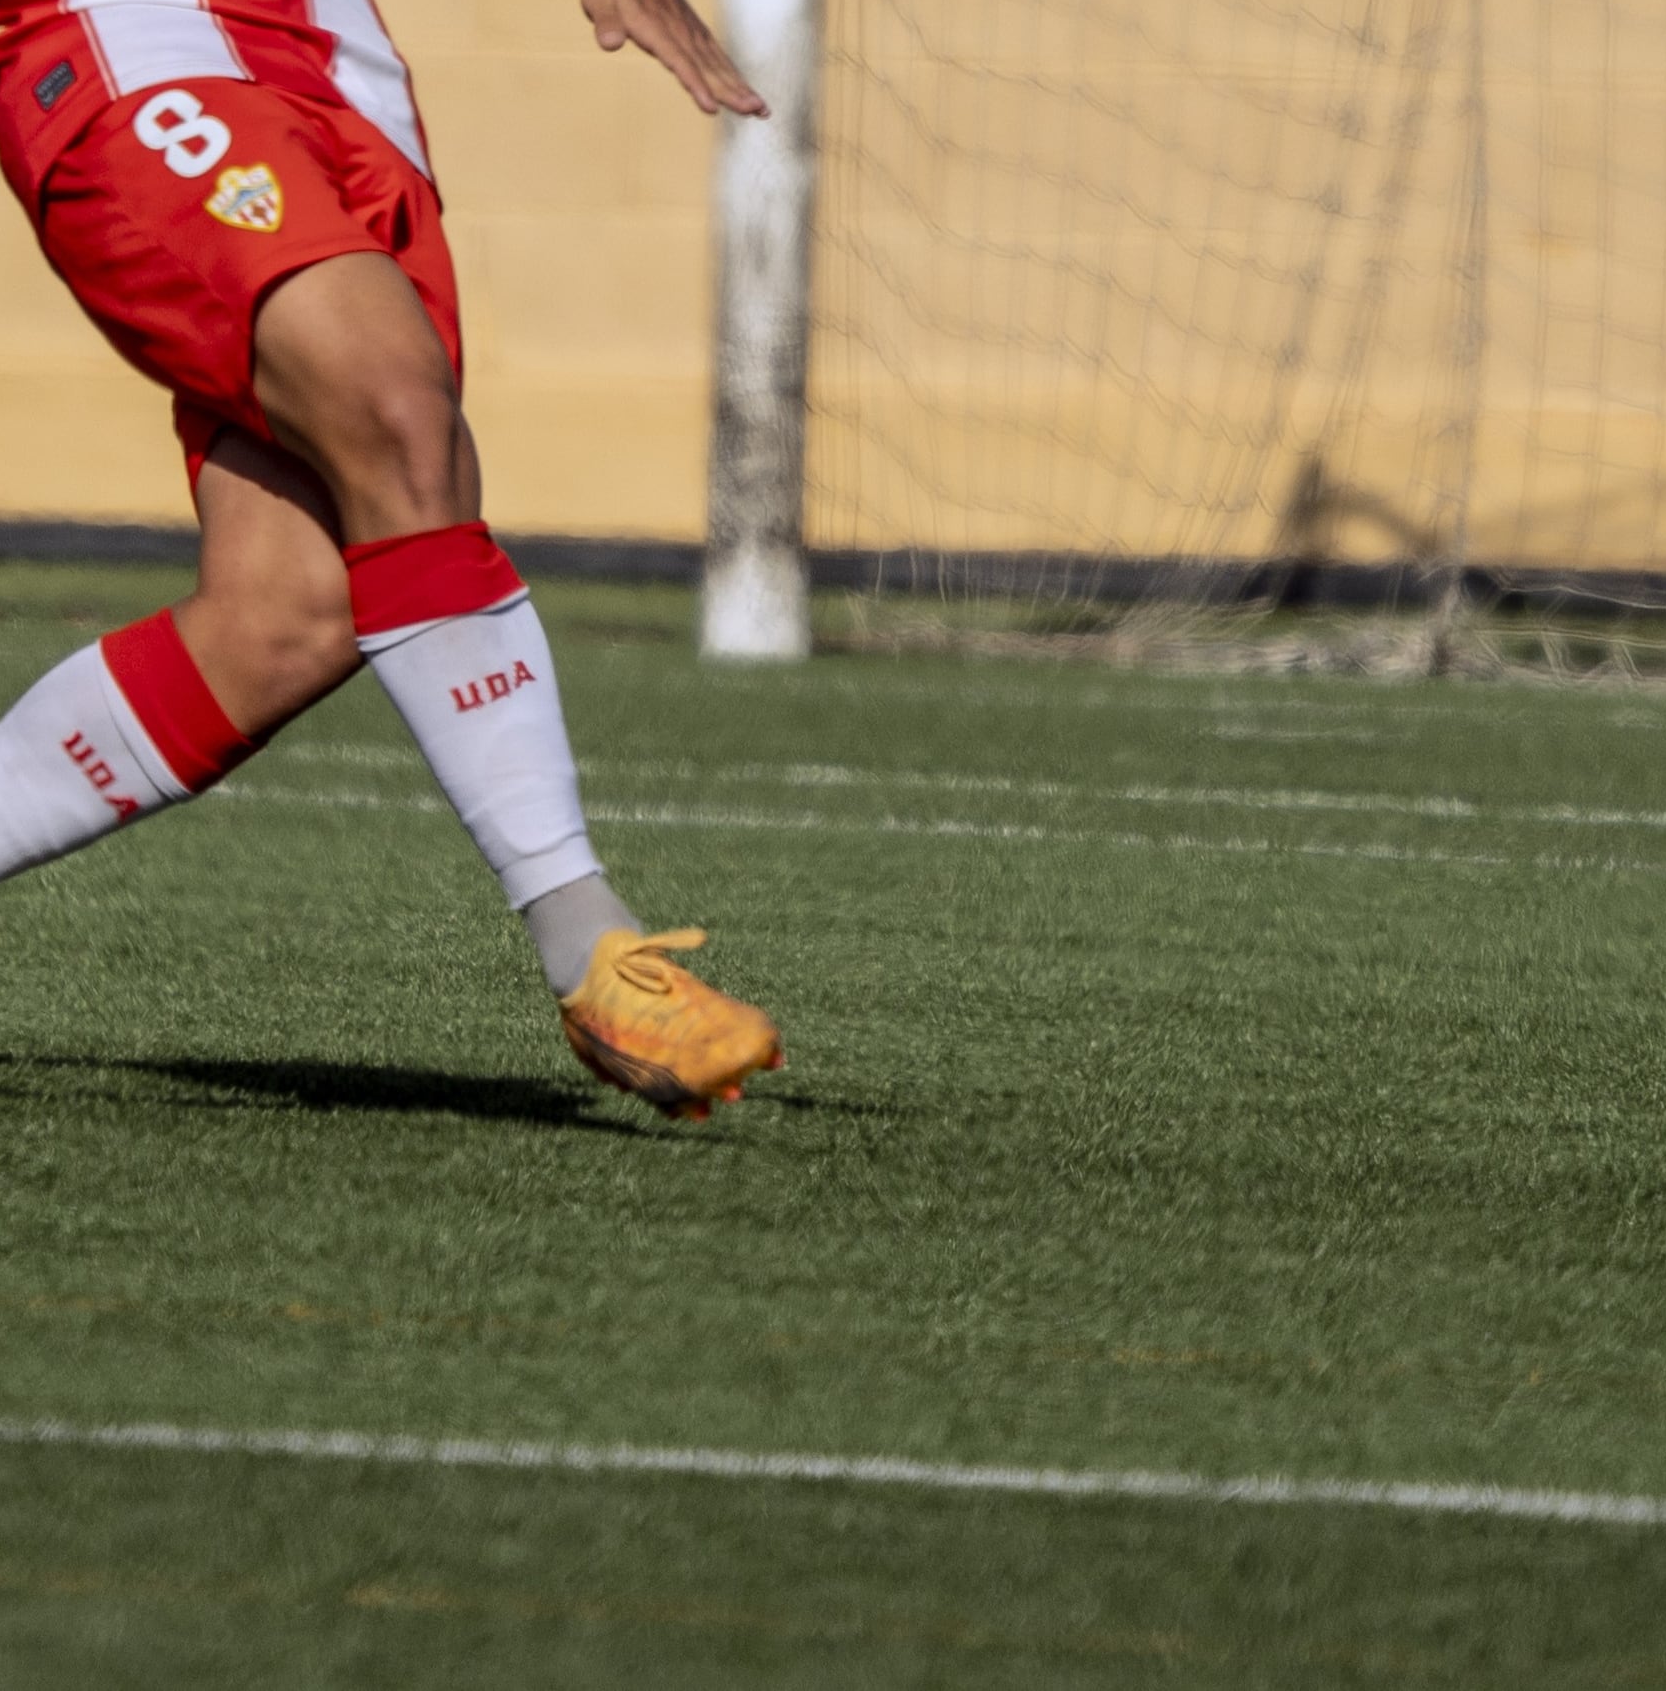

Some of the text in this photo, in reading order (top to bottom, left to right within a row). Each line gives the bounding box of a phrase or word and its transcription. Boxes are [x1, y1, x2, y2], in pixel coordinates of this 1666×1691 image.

[133, 89, 232, 177] 8
[449, 660, 537, 714] UDA
[62, 729, 140, 824] UDA
